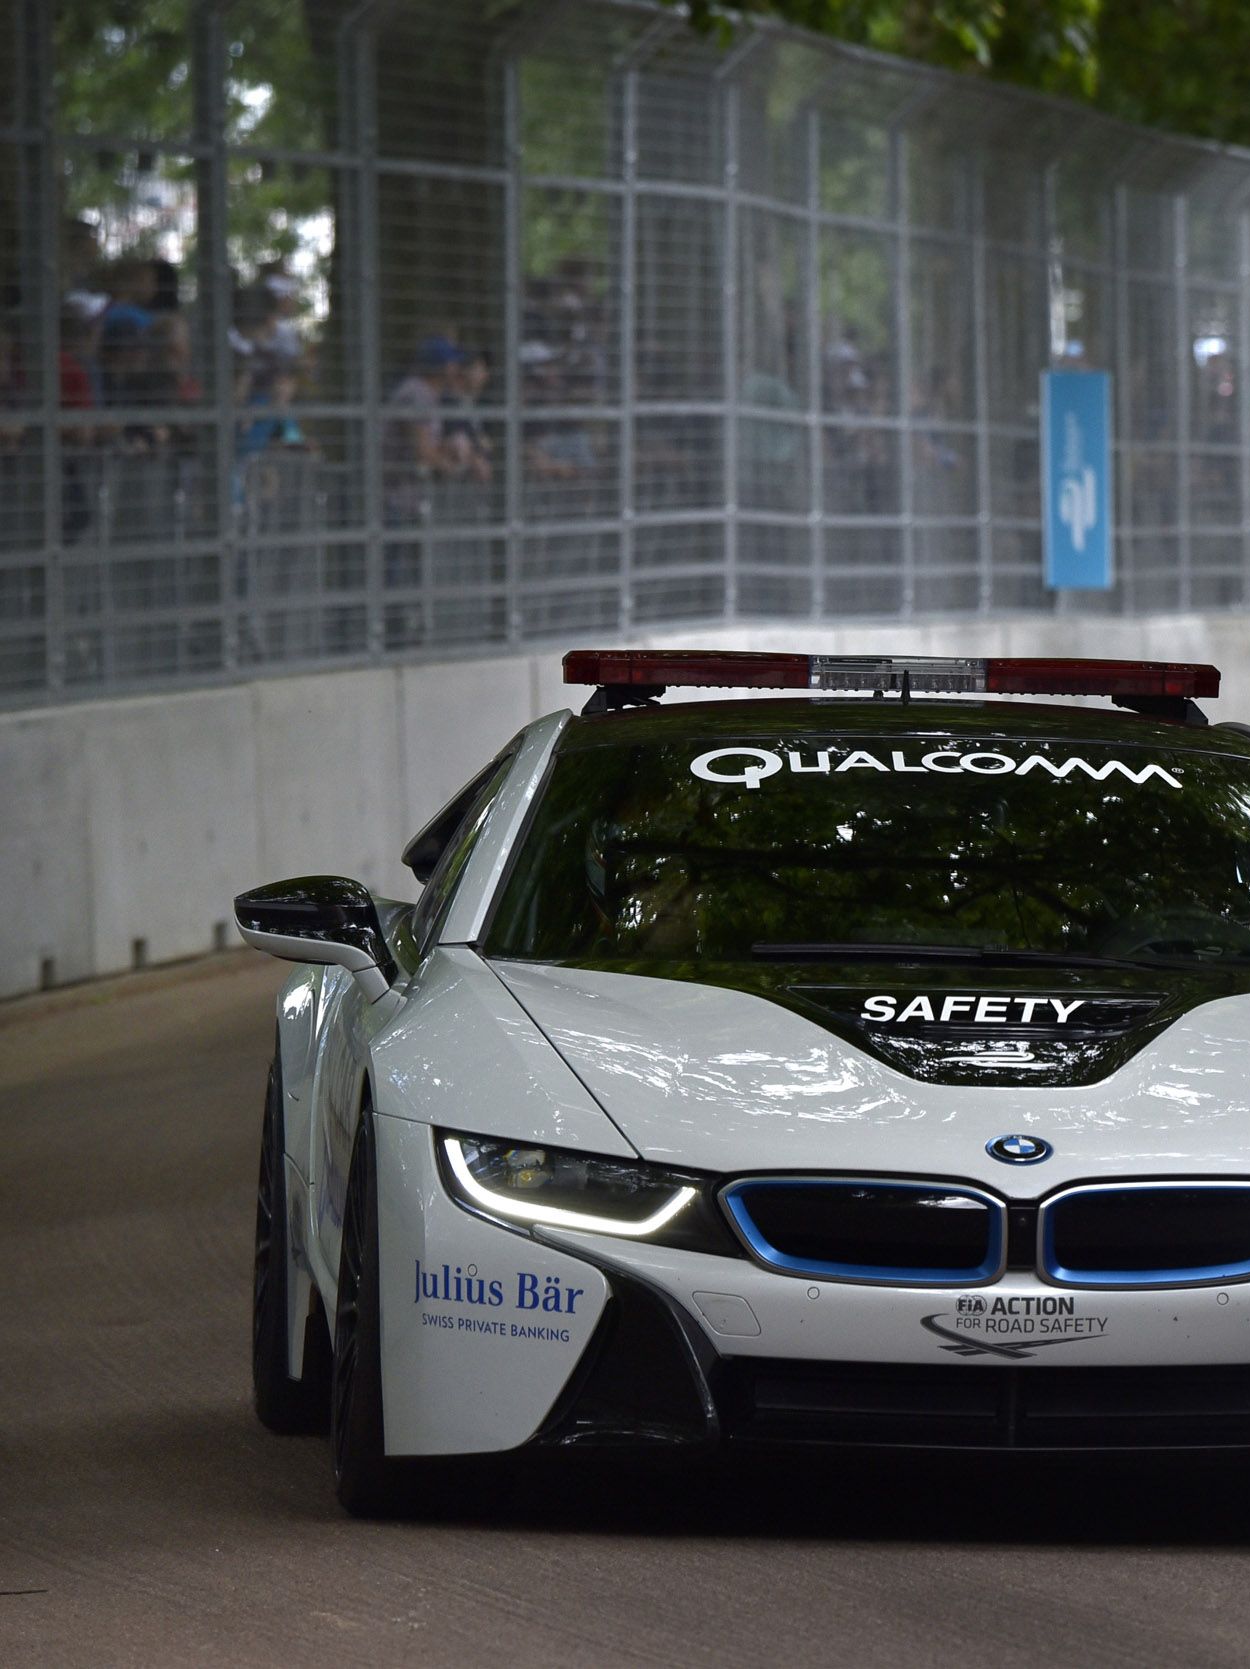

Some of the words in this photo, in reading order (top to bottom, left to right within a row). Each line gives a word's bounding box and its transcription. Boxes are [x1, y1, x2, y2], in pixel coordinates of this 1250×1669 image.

[860, 995, 1086, 1023] SAFETY
[414, 1259, 504, 1307] Julius
[515, 1272, 585, 1314] Bär
[990, 1296, 1074, 1316] ACTION
[422, 1312, 454, 1329] SWISS
[458, 1317, 506, 1336] PRIVATE
[510, 1323, 570, 1343] BANKING
[956, 1317, 981, 1329] FOR
[985, 1318, 1035, 1334] ROAD
[1039, 1317, 1108, 1333] SAFETY
